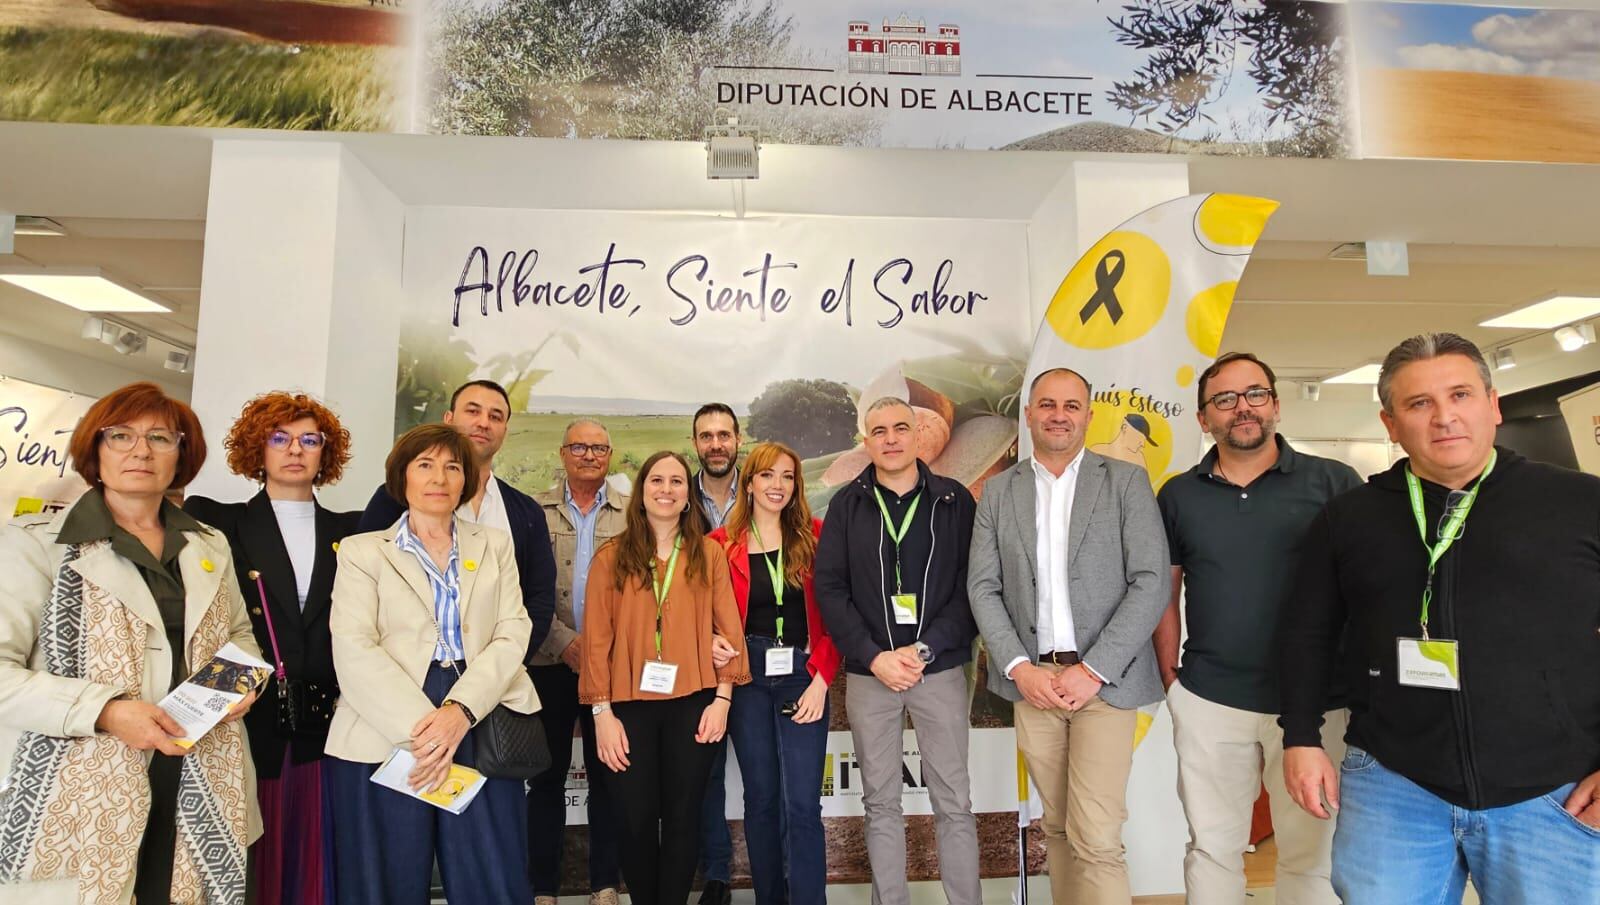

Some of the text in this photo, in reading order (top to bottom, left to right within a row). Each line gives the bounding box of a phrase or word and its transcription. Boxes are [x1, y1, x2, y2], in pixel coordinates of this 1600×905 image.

[716, 81, 1093, 116] DIPUTACIÓN DE ALBACETE
[452, 243, 988, 328] Albacete, Siente el Sabor
[1088, 383, 1184, 419] uís Esteso
